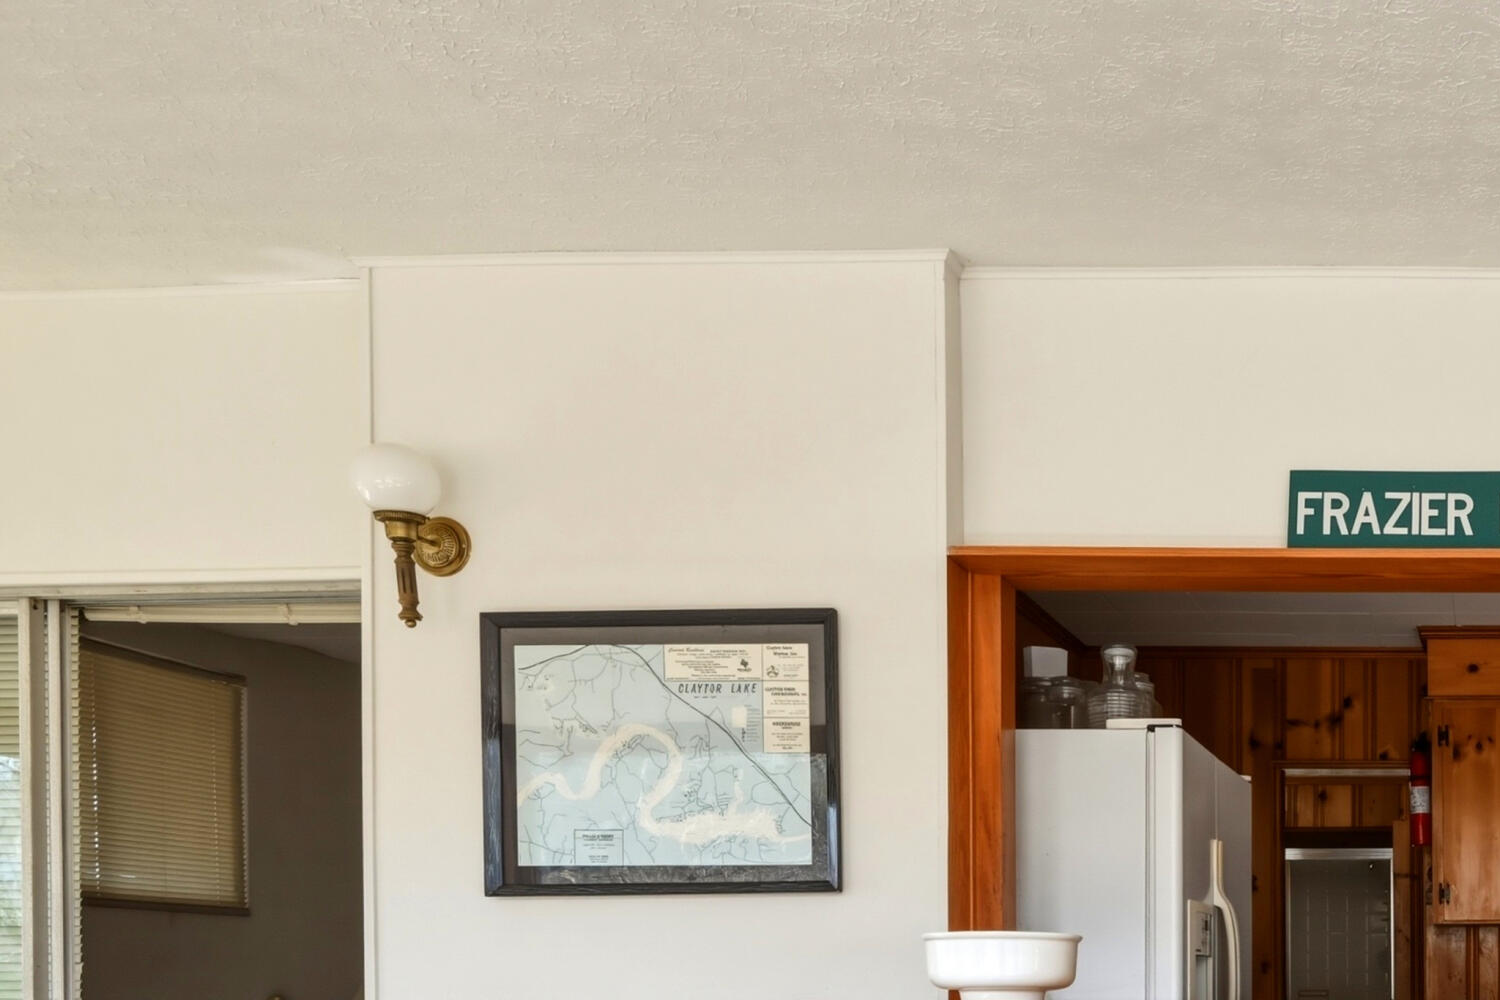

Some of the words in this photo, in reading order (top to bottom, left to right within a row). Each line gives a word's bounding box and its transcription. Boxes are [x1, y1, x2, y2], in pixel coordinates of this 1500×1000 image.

[1296, 491, 1475, 536] FRAZIER
[678, 683, 722, 694] CLAYTOR
[730, 683, 757, 694] LAKE
